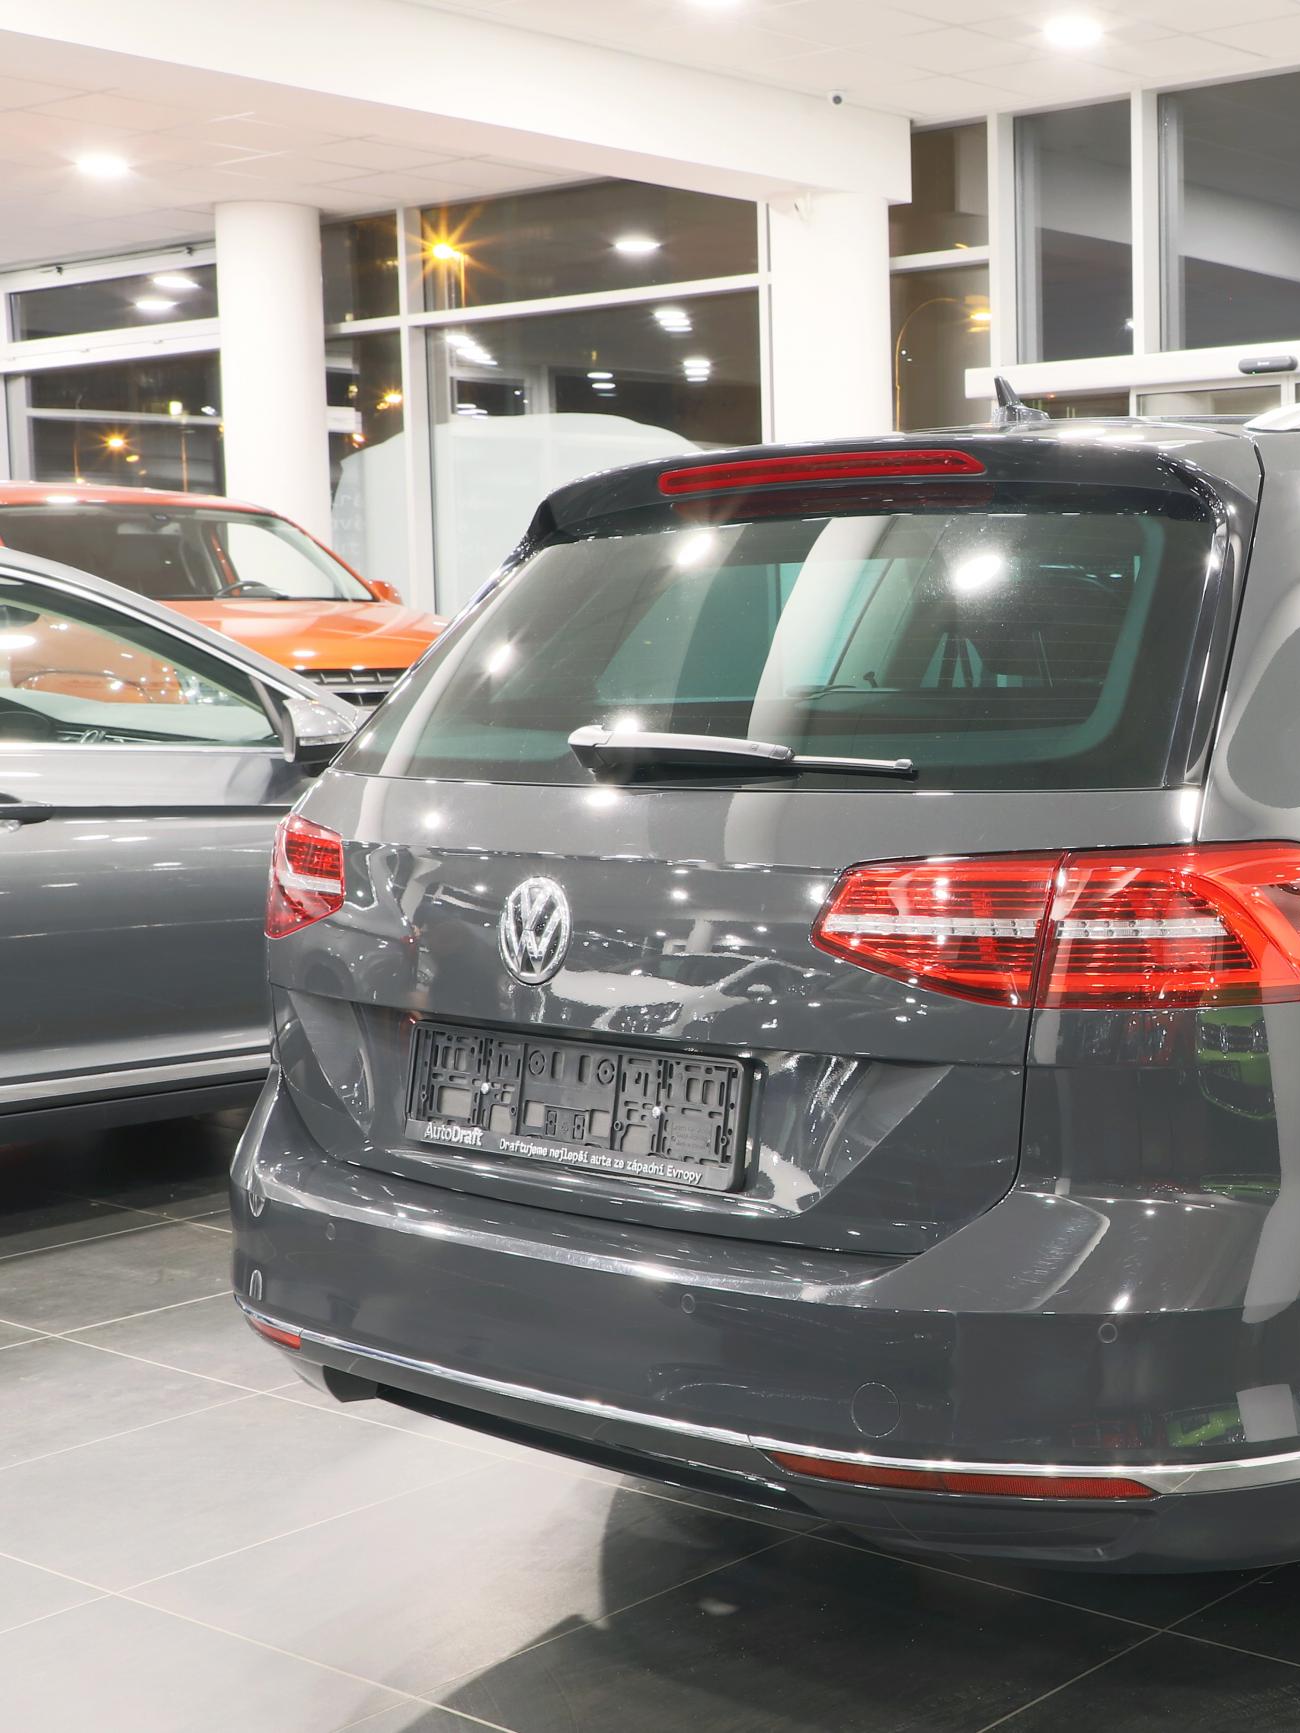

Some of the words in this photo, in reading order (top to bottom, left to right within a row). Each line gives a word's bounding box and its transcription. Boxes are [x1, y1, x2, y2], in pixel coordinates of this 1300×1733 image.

[502, 878, 568, 983] VW
[424, 1121, 483, 1146] AutoDraft
[499, 1138, 548, 1156] Draftujeme
[549, 1146, 588, 1163] nejlepší
[590, 1154, 612, 1167] auta
[613, 1157, 625, 1169] ze
[627, 1159, 665, 1176] západní
[666, 1164, 702, 1184] Evropy
